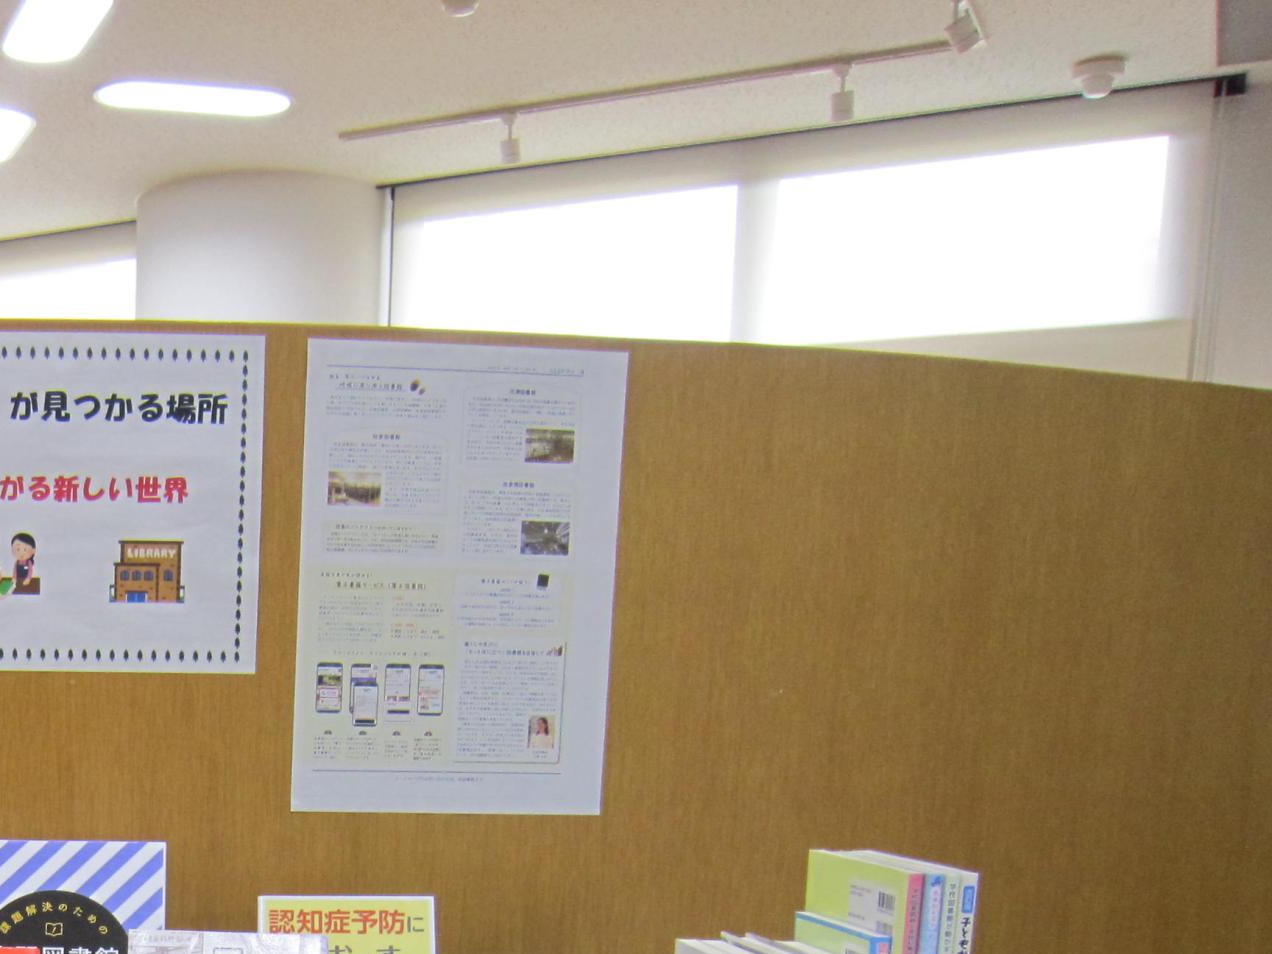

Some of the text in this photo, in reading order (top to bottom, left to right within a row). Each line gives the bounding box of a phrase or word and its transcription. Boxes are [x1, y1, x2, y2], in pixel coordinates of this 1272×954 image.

[127, 548, 177, 560] LIBRARY
[269, 909, 425, 935] 認知症予防に
